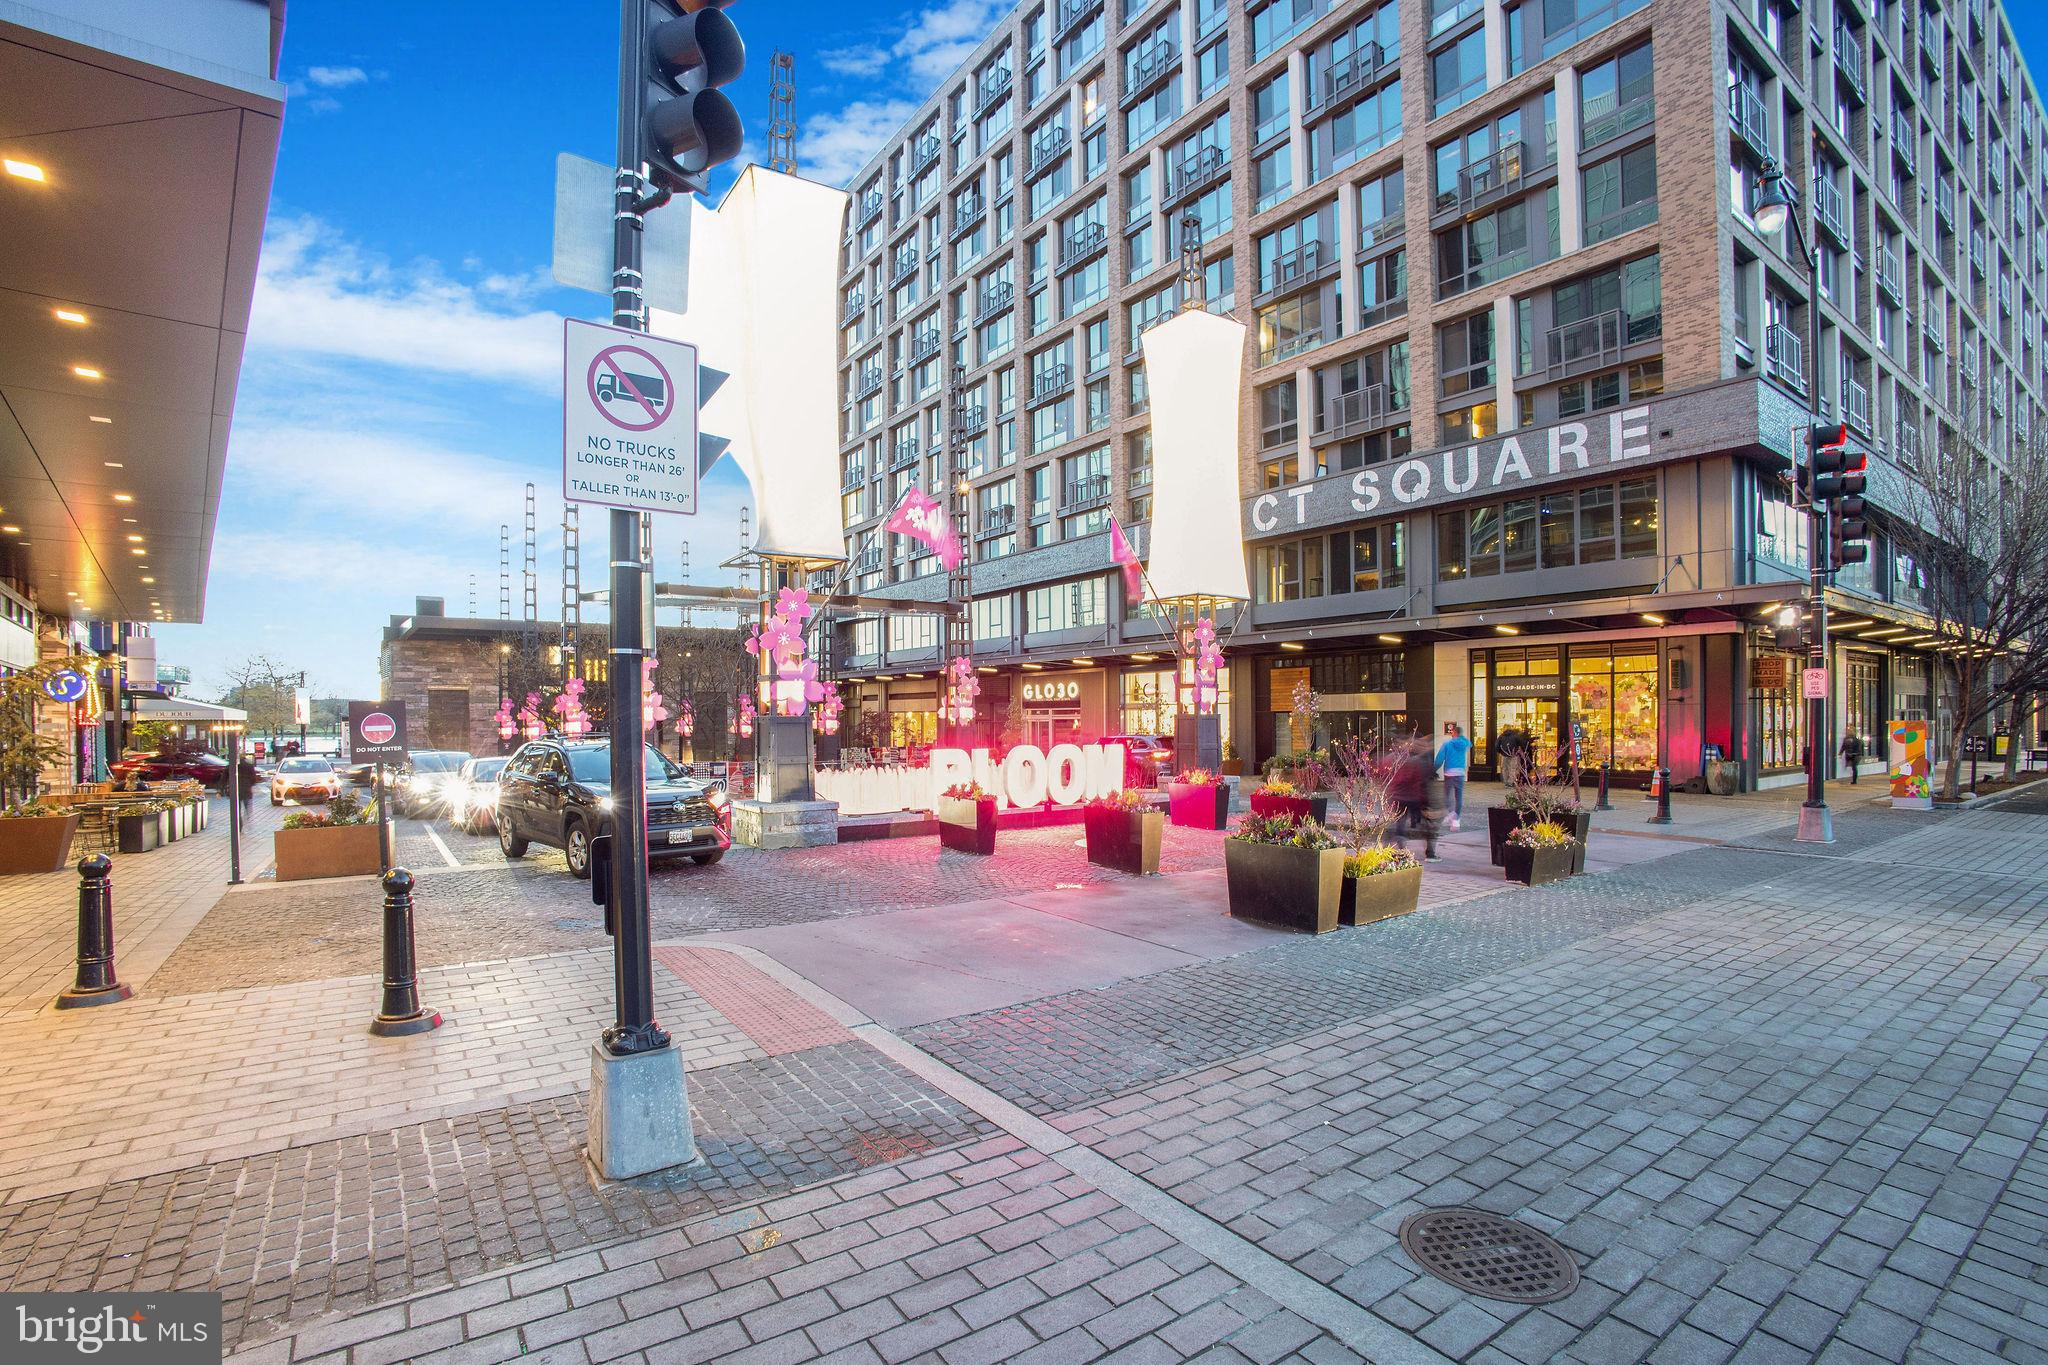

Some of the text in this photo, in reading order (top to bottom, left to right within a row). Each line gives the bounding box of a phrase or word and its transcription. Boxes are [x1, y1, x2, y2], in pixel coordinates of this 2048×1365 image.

[588, 435, 676, 461] NO TRUCKS
[577, 452, 685, 476] LONGER THAN 26'
[1252, 405, 1651, 532] CT SQUARE
[572, 479, 619, 495] TALLER
[623, 486, 656, 500] THAN
[625, 474, 639, 483] OR
[929, 744, 1125, 814] BLOOM
